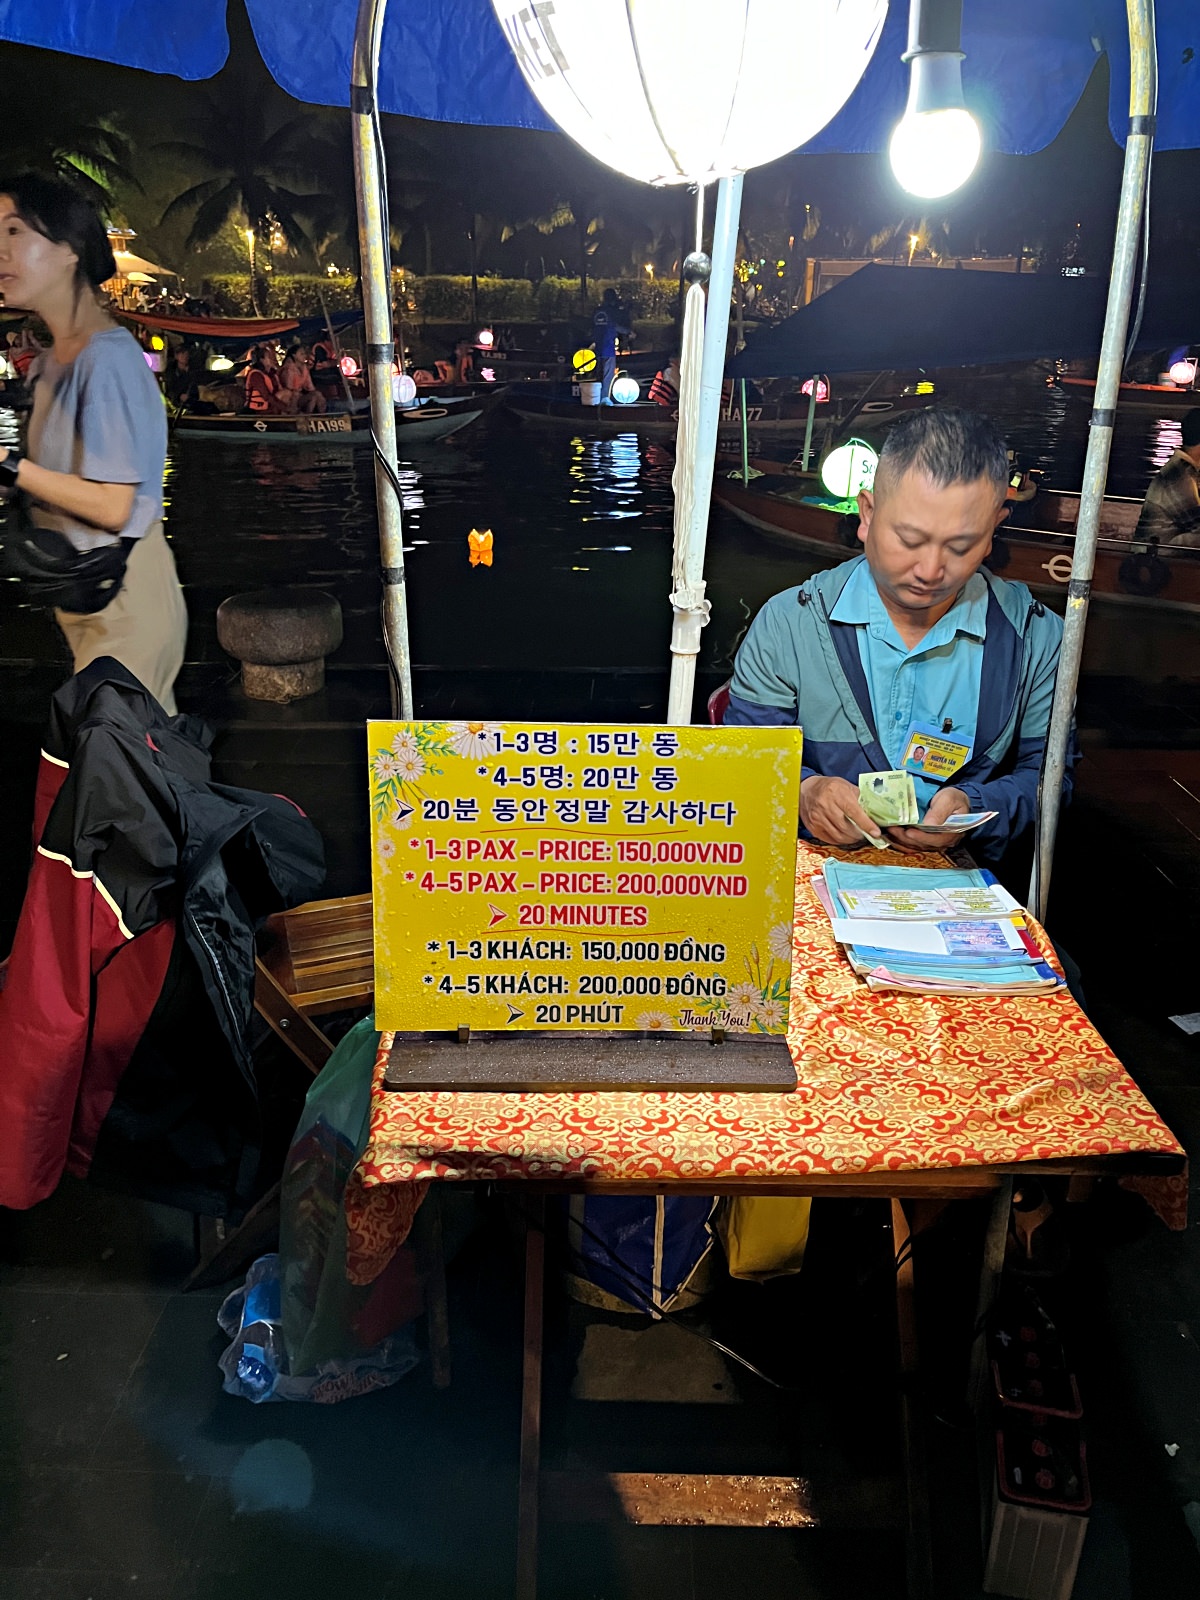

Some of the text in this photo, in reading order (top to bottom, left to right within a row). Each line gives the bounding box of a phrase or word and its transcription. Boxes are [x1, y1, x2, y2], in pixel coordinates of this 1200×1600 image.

[652, 733, 679, 757] 동
[651, 767, 678, 791] 동
[423, 798, 480, 822] 20분
[623, 800, 737, 826] 감사하다
[539, 840, 611, 861] PRICE:
[617, 841, 743, 864] 150,000VND
[540, 872, 612, 894] PRICE:
[617, 873, 747, 896] 200,000VND
[519, 905, 647, 926] 20 MINUTES
[487, 937, 571, 960] KHÁCH:
[581, 941, 660, 962] 150,000
[663, 937, 725, 962] ĐỒNG
[485, 971, 569, 994] KHÁCH:
[578, 975, 661, 996] 200,000
[665, 971, 726, 996] ĐỒNG
[536, 1001, 624, 1023] 20 PHÚT
[679, 1009, 751, 1027] Thank You!
